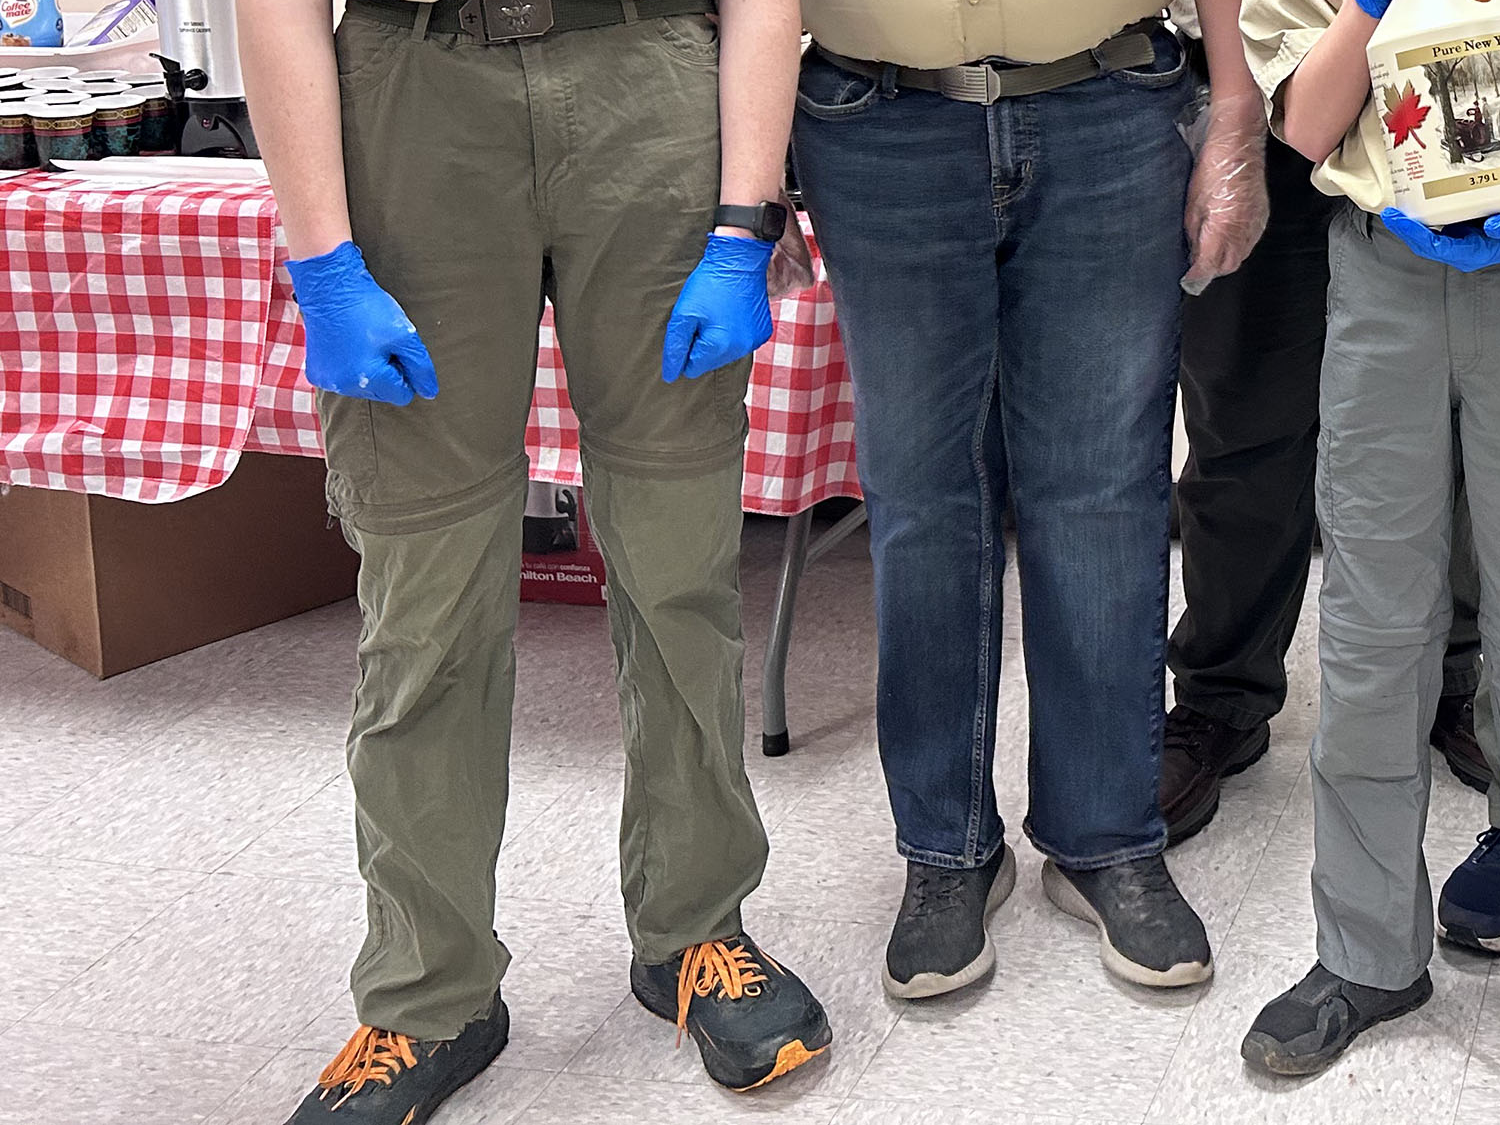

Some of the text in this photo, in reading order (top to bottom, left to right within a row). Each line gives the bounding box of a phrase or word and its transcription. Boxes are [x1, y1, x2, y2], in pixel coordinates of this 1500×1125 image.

[1, 1, 31, 12] Coffee
[6, 9, 32, 18] mate
[1431, 44, 1462, 58] Pure
[1463, 39, 1493, 52] New
[1469, 172, 1498, 186] 3.79 L
[556, 571, 598, 584] Beach
